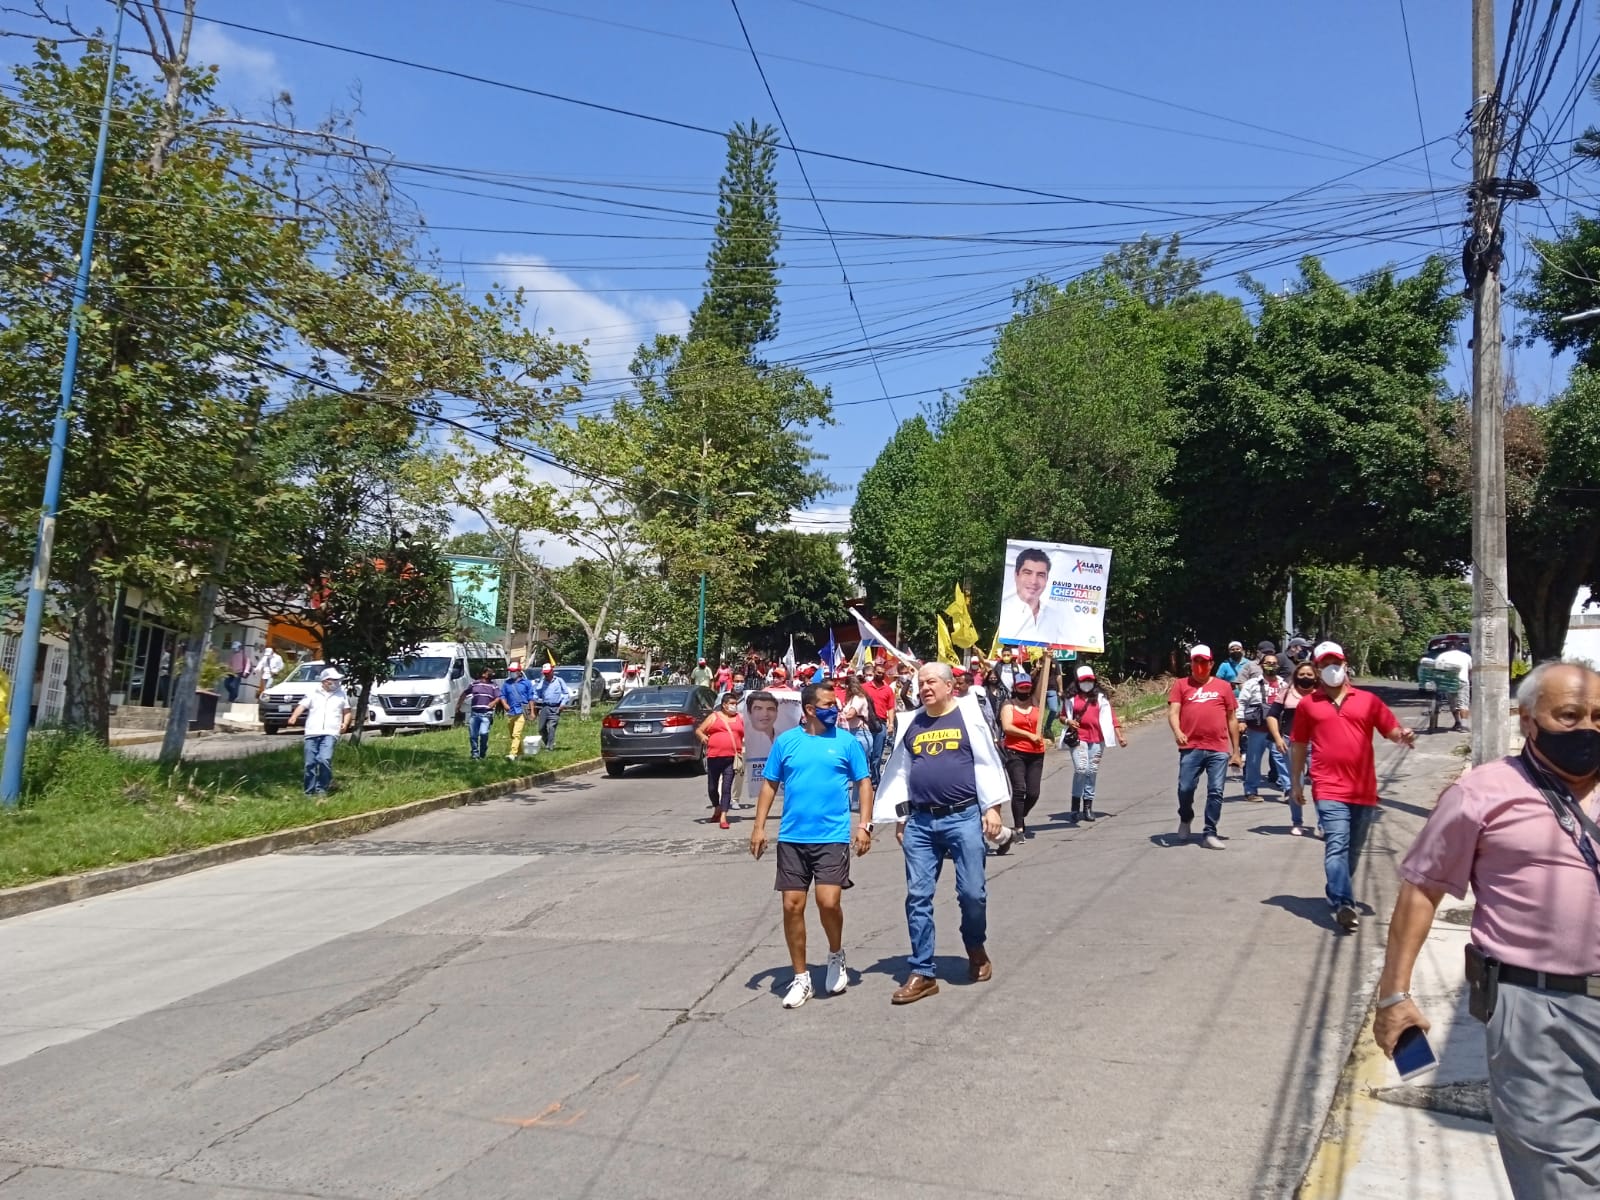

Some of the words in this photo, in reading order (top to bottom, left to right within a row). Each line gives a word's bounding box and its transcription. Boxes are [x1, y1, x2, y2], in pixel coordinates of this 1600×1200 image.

[1072, 559, 1103, 574] XALAPA
[1052, 580, 1072, 588] DAVID
[1073, 583, 1102, 591] VELASCO
[1053, 587, 1098, 599] CHEDRAU
